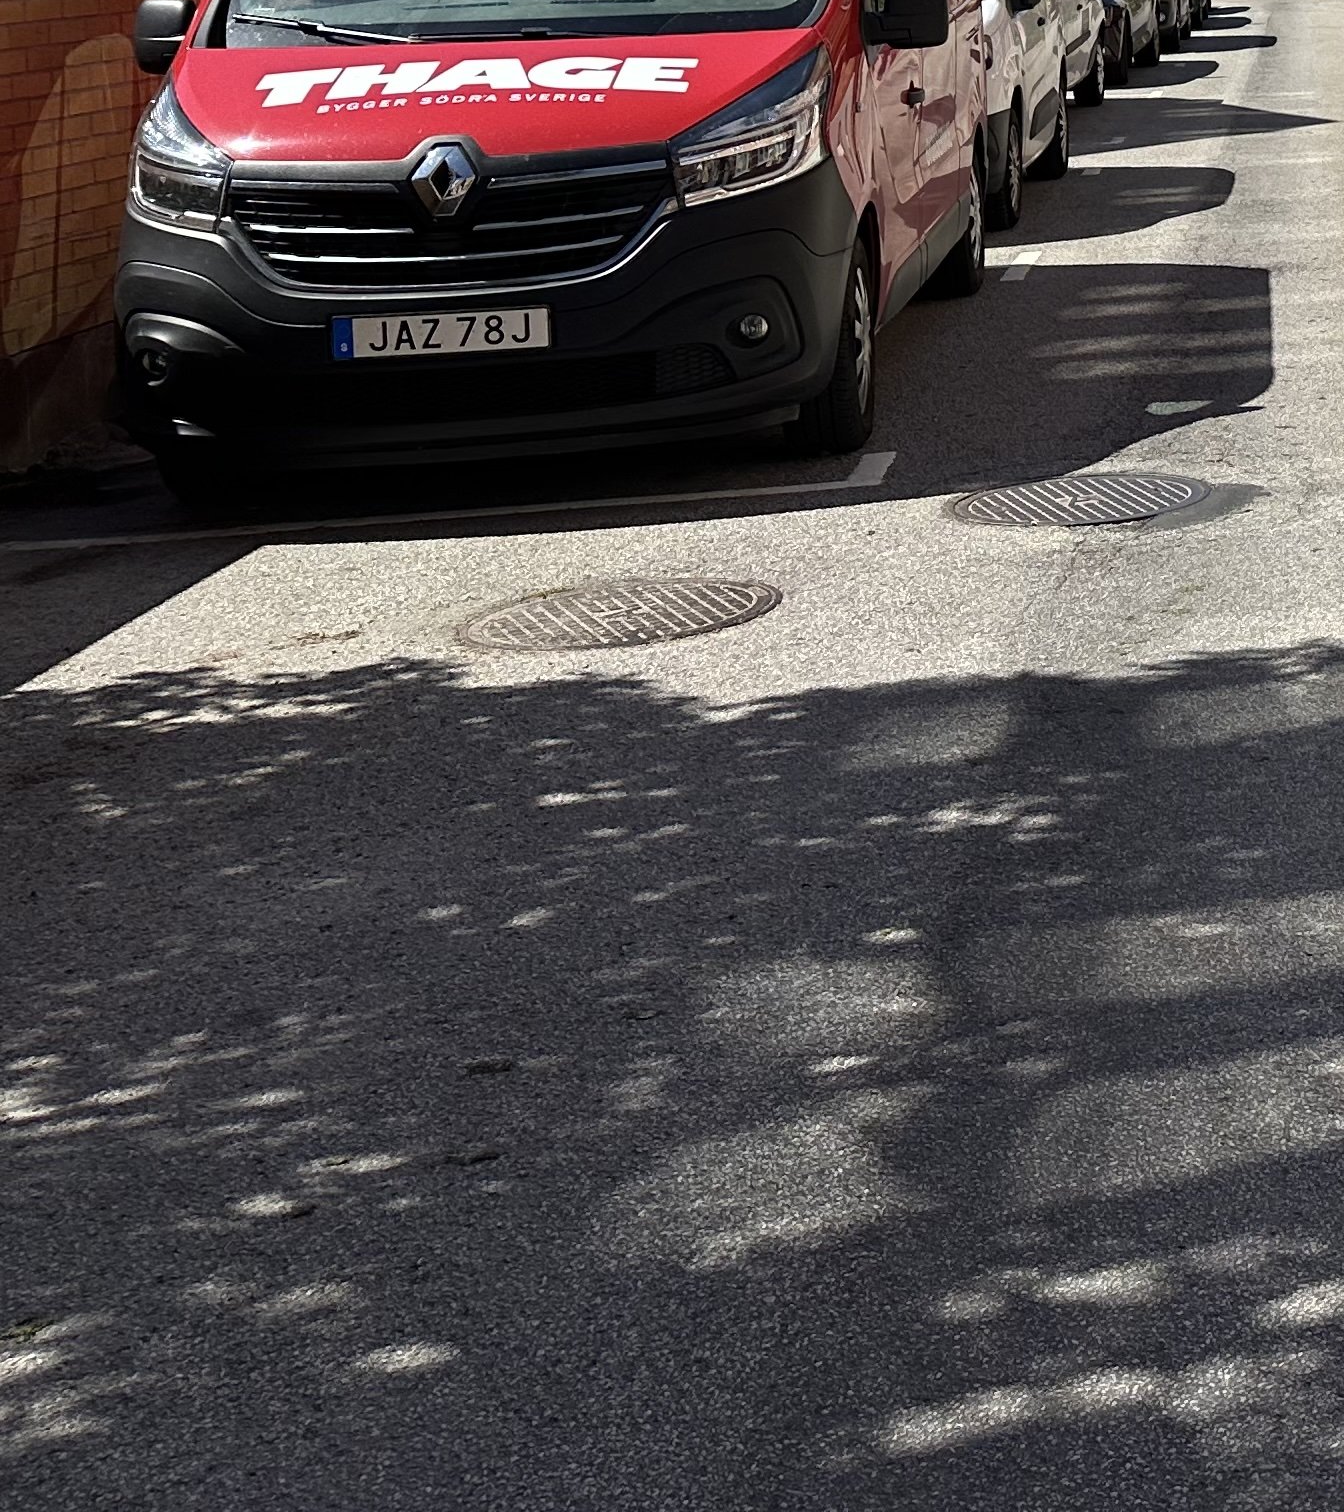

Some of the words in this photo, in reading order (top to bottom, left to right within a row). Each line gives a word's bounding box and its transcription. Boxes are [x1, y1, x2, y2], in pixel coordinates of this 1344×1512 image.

[255, 56, 699, 108] THAGE
[316, 97, 408, 114] BYGGER
[419, 93, 497, 106] SÖDRA
[508, 92, 607, 104] SVERIGE
[369, 318, 442, 351] JAZ
[456, 312, 531, 347] 78J
